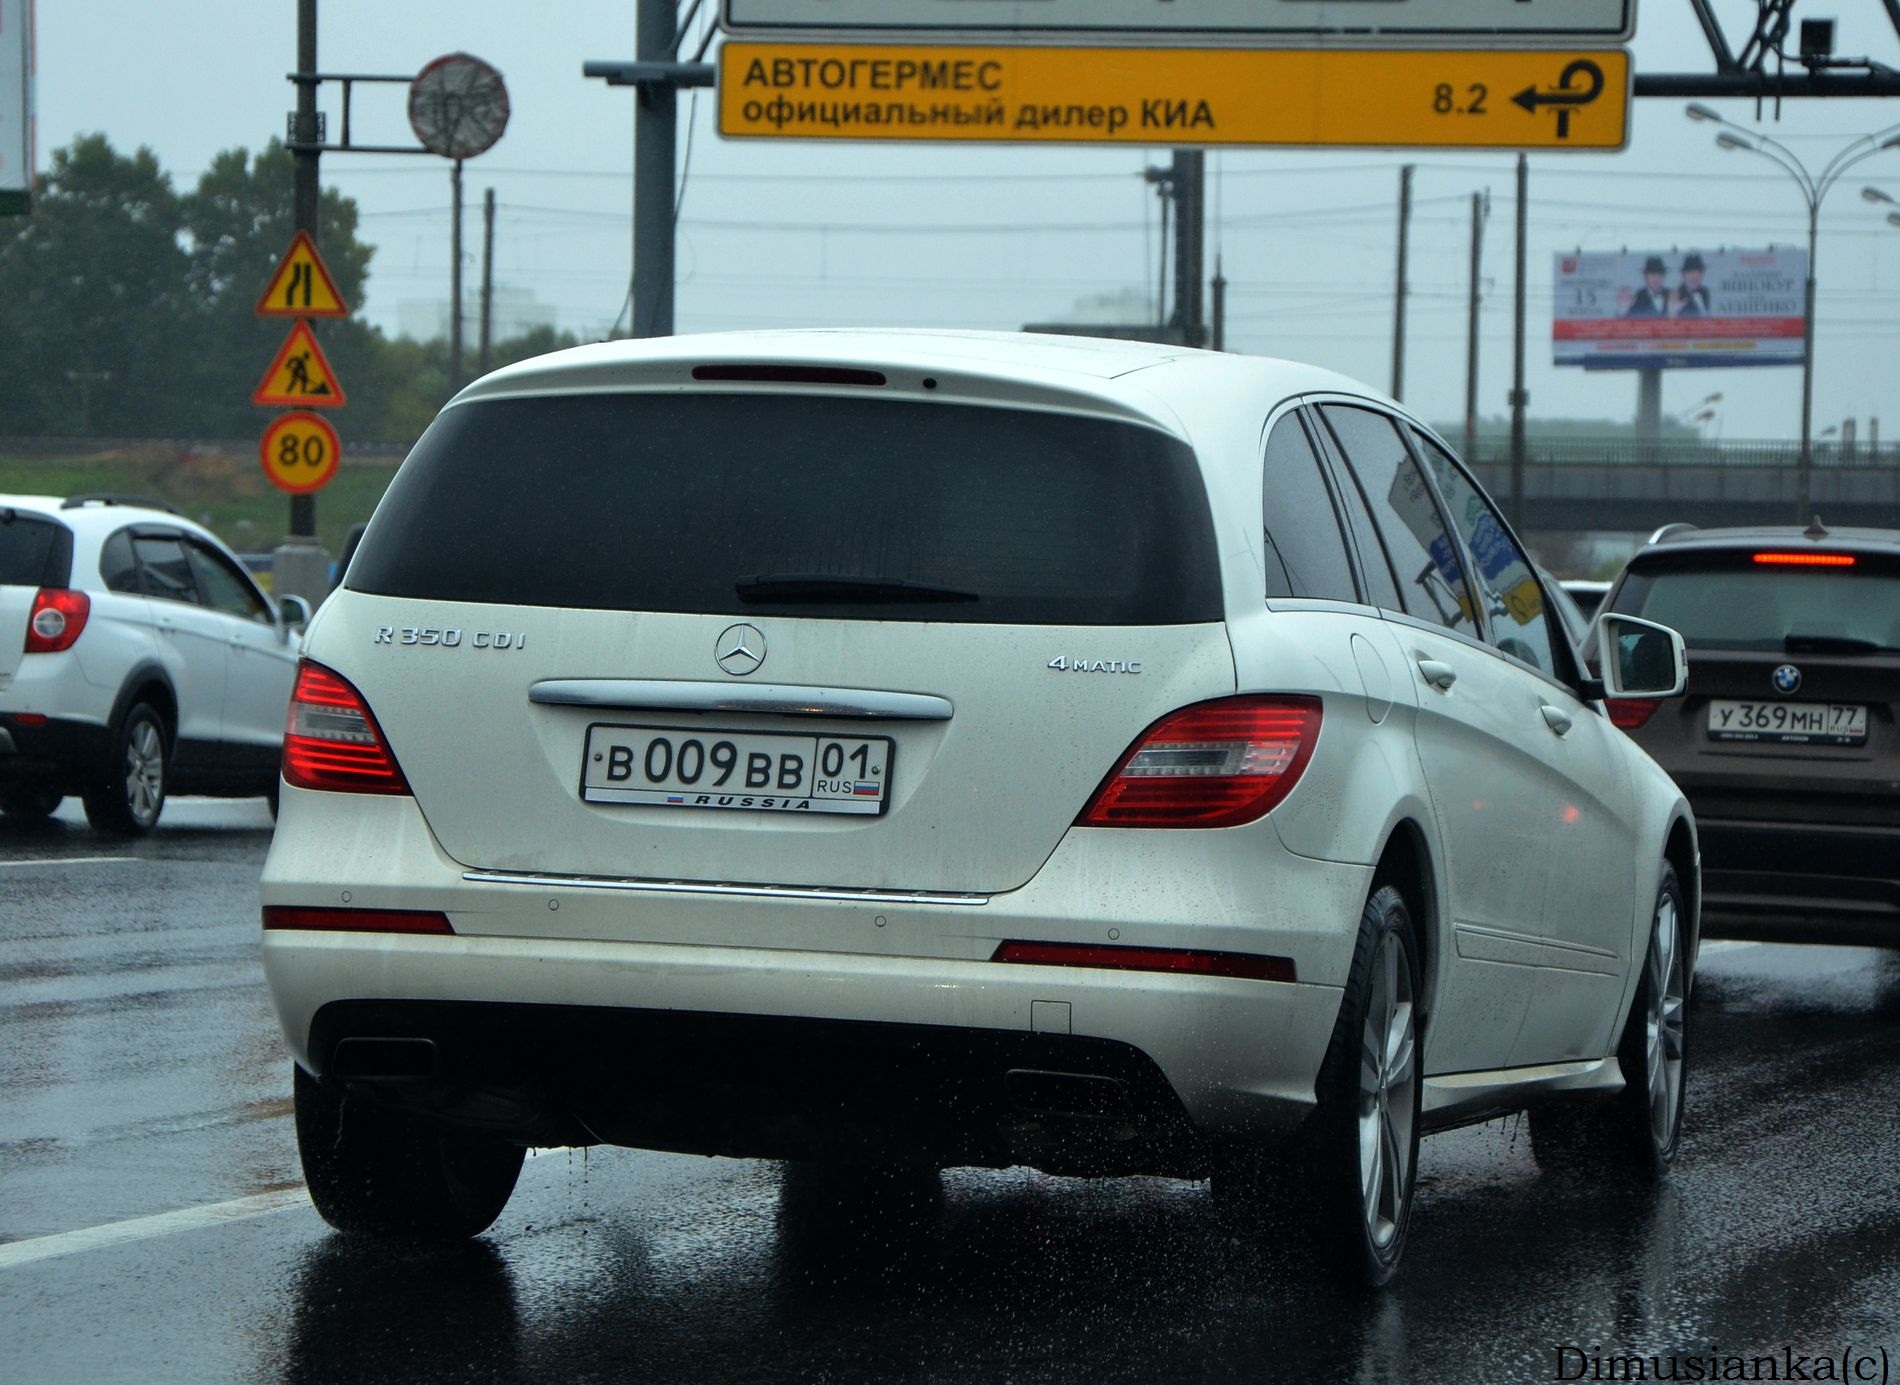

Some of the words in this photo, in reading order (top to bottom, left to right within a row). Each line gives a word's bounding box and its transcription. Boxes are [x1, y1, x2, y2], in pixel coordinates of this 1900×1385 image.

[743, 57, 1002, 91] АВТОГЕРМЕС
[742, 94, 1006, 129] официальный
[1015, 103, 1129, 134] дилер
[1141, 98, 1216, 129] КИА
[1433, 83, 1488, 115] 8.2
[279, 433, 324, 468] 80
[374, 626, 394, 644] R
[400, 627, 462, 647] 350
[472, 631, 525, 649] CDI
[1832, 706, 1858, 726] 77
[822, 743, 869, 779] 01
[694, 795, 811, 810] RUSSIA
[817, 780, 852, 794] RUS
